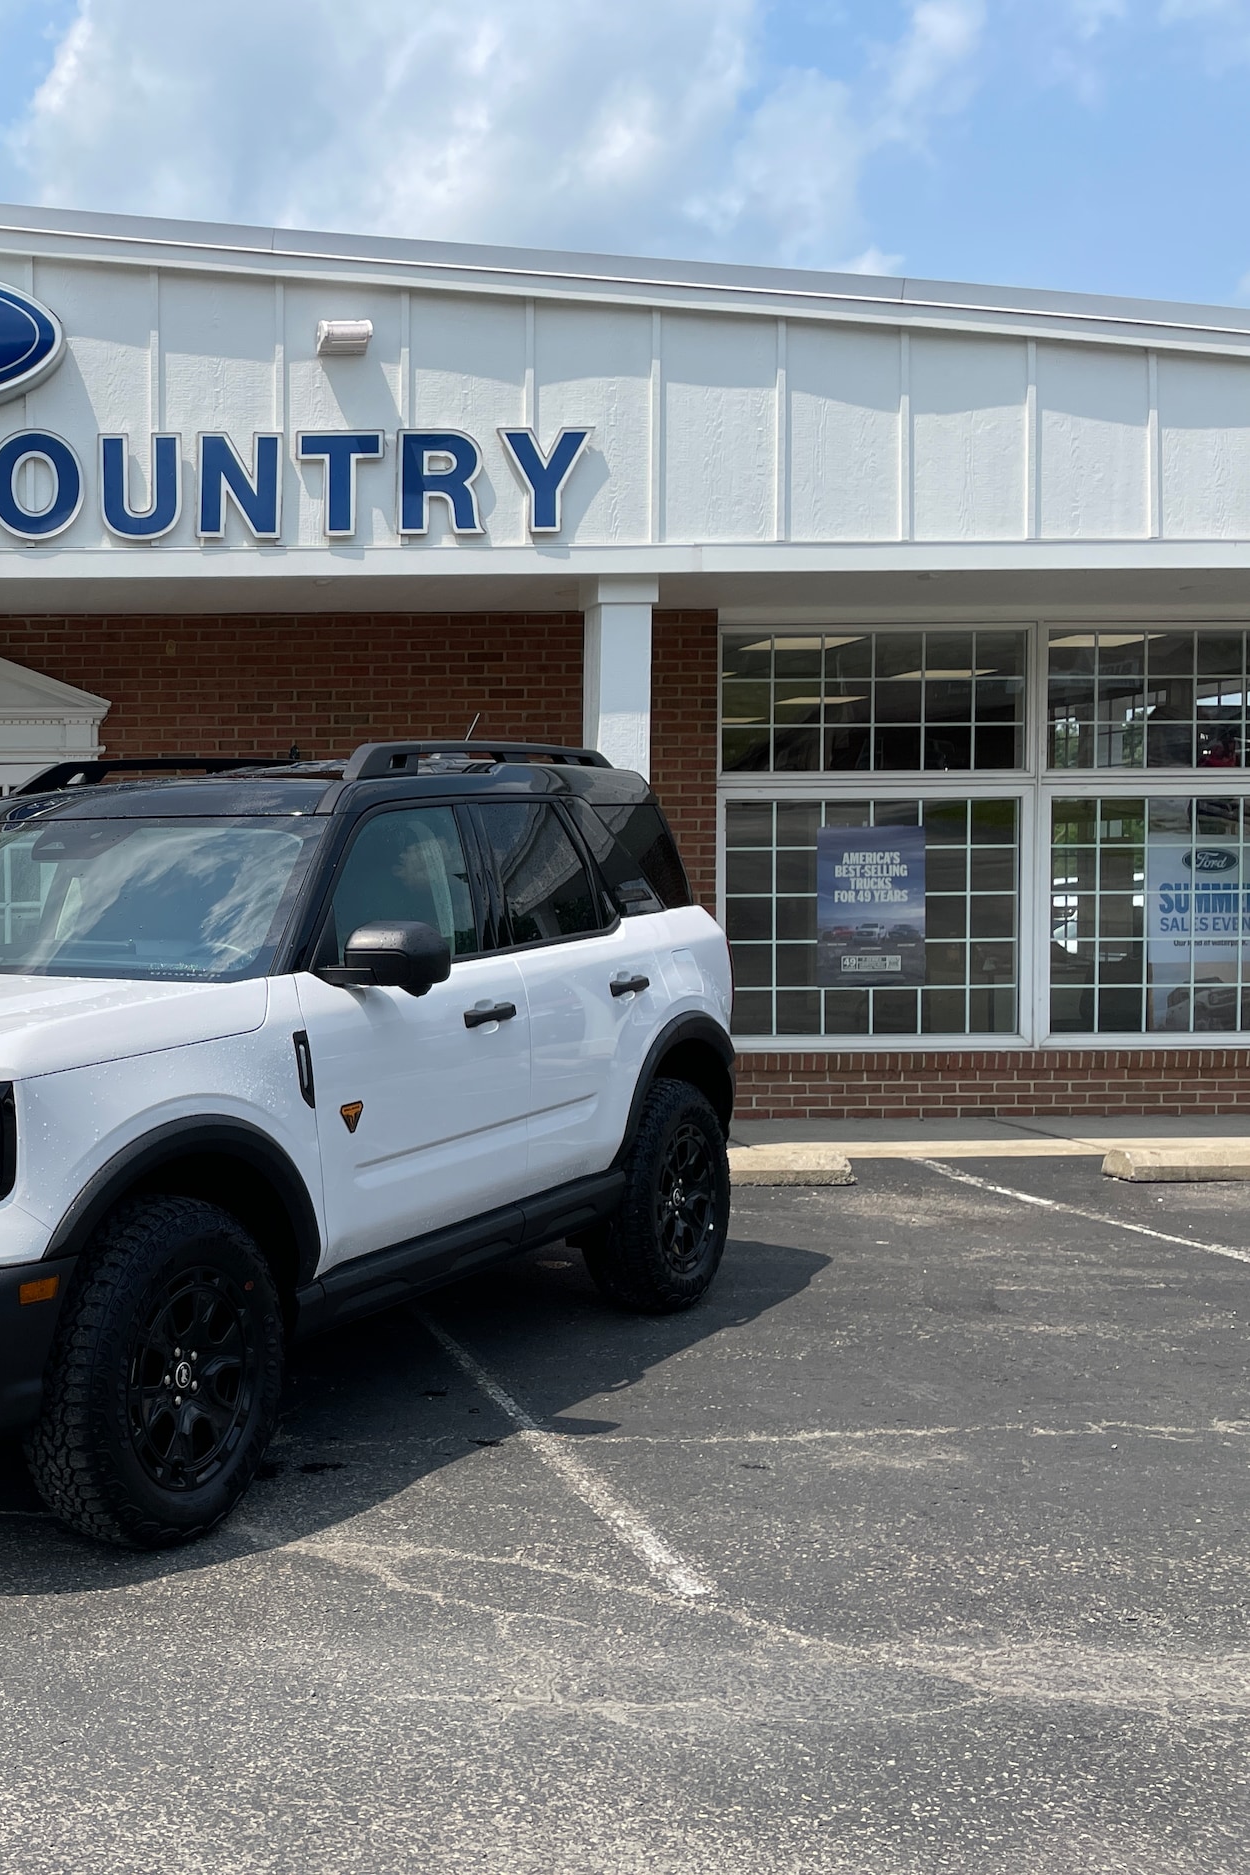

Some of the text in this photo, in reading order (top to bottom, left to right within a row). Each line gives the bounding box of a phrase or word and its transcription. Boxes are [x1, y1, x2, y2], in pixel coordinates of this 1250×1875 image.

[842, 852, 900, 865] AMERICA'S
[1196, 852, 1227, 868] Ford
[834, 865, 908, 878] BEST-SELLING
[850, 878, 892, 890] TRUCKS
[834, 890, 909, 903] FOR 49 YEARS
[1159, 883, 1250, 914] SUMME
